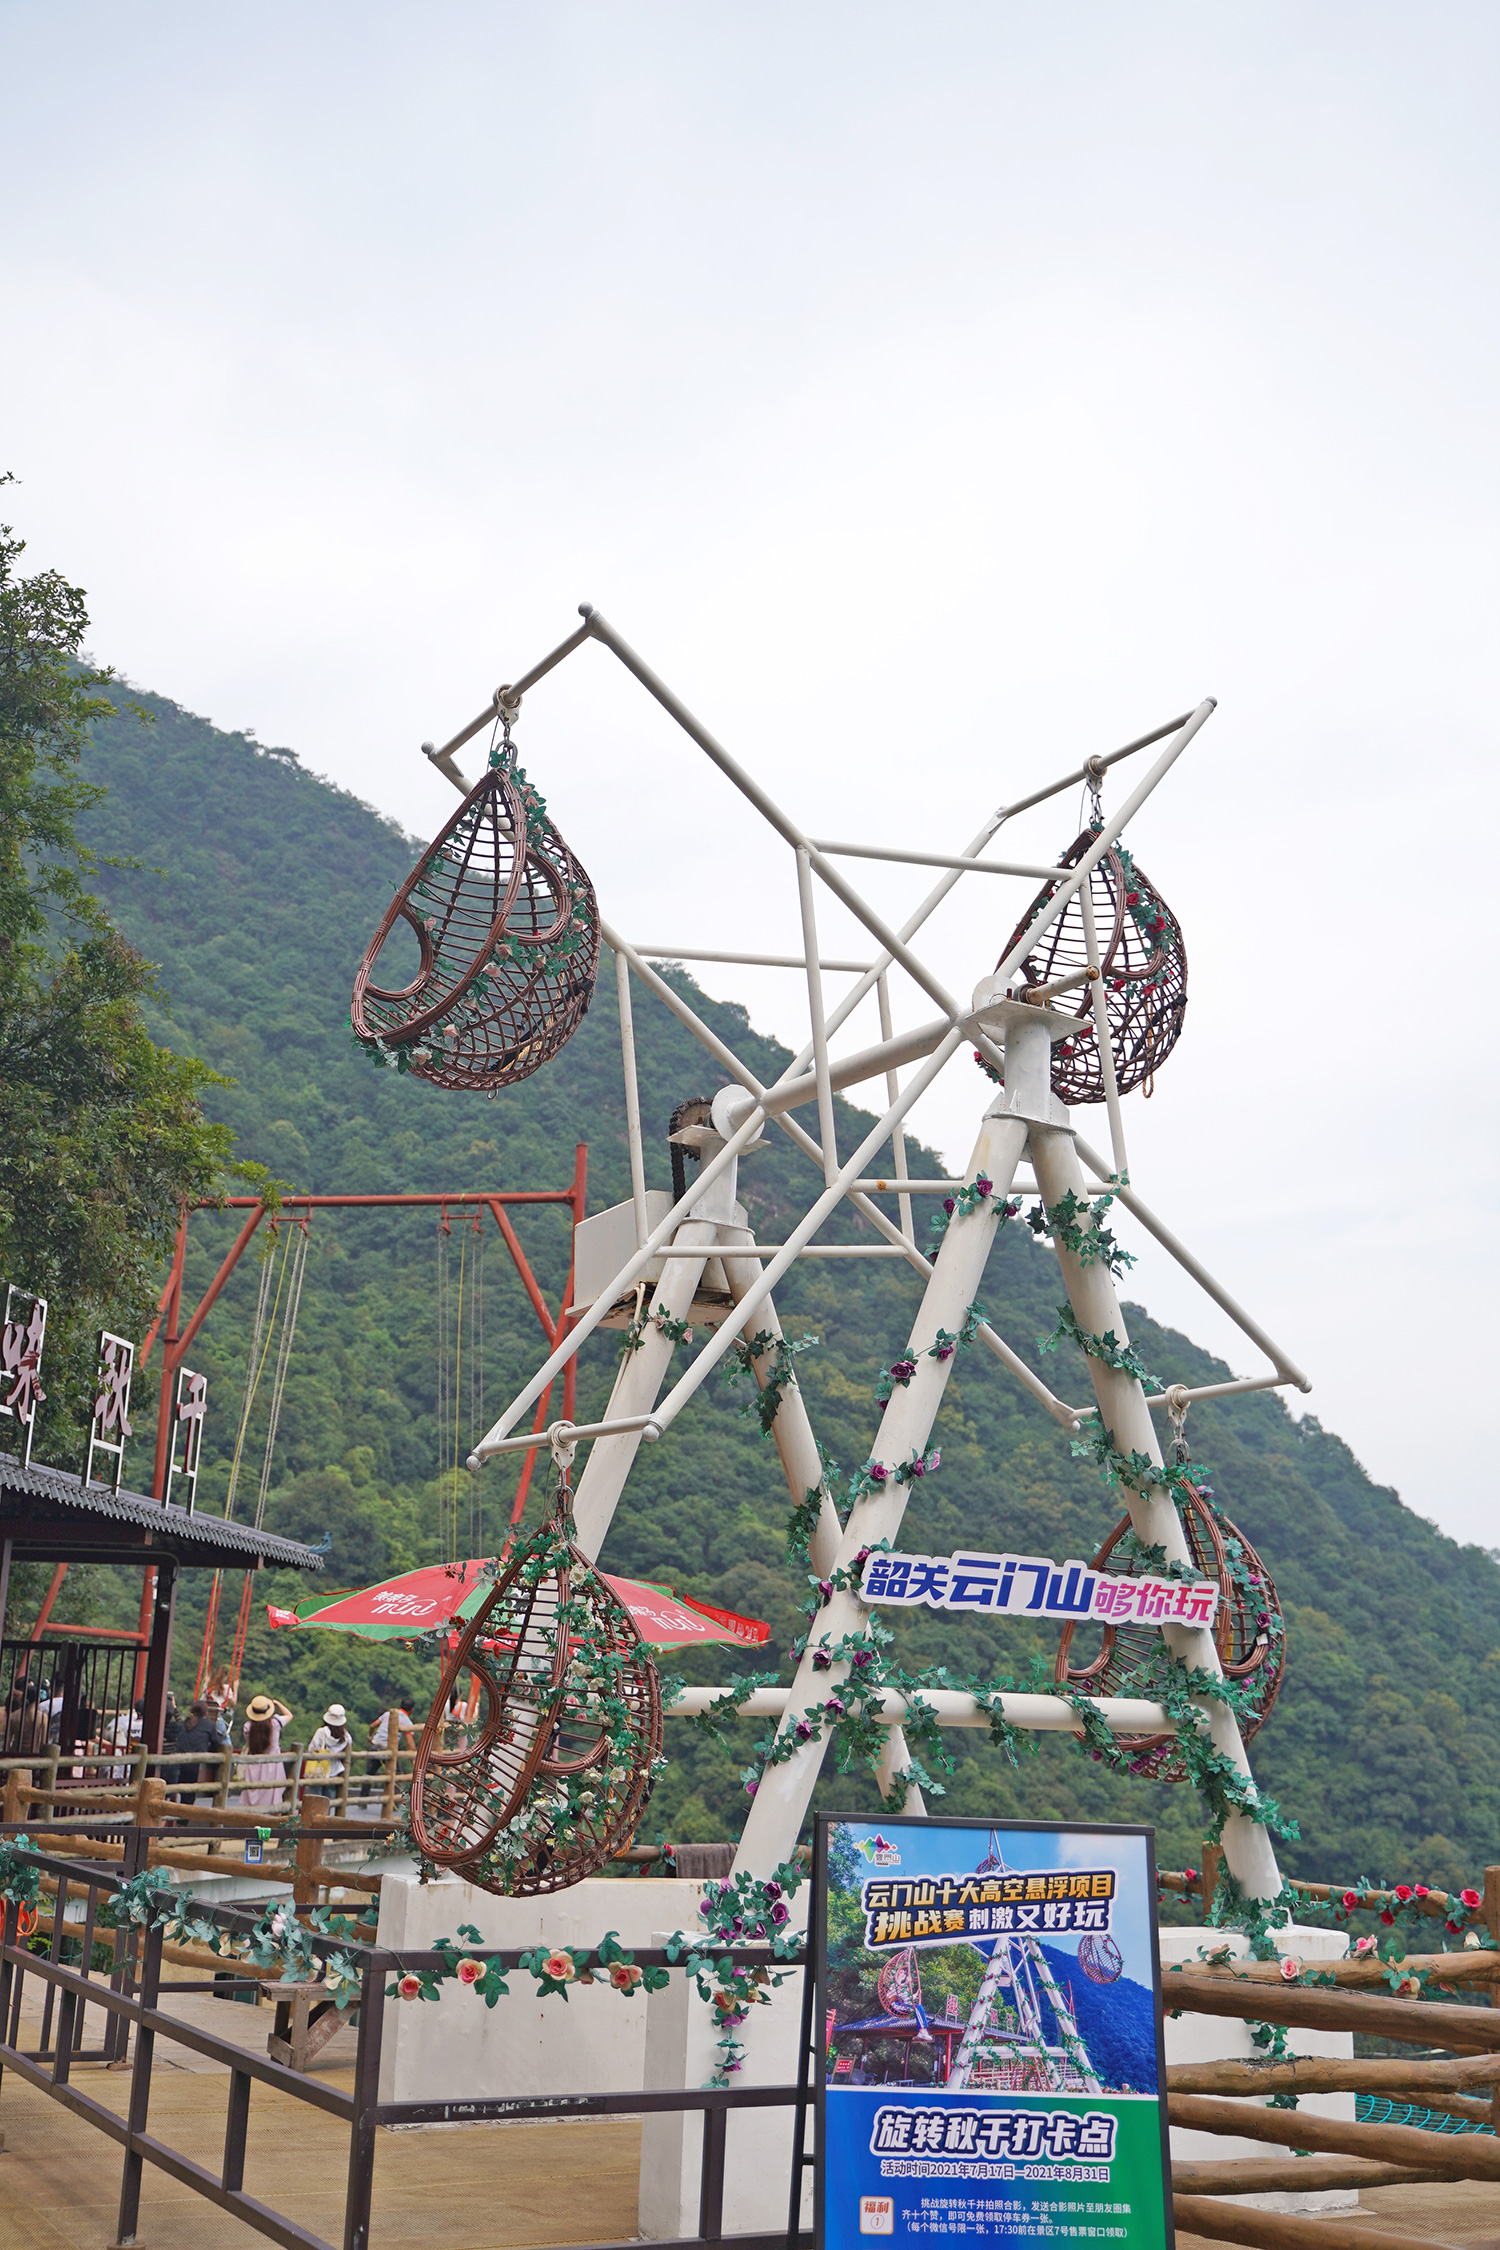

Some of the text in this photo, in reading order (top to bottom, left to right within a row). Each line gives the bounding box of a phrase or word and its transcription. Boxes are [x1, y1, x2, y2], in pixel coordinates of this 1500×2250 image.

[866, 1558, 1215, 1622] 韶关云门山够你玩
[867, 1873, 1113, 1908] 云门山十大高空悬浮项目
[877, 2114, 1112, 2153] 旋转秋千打卡点
[864, 2201, 889, 2214] 福利
